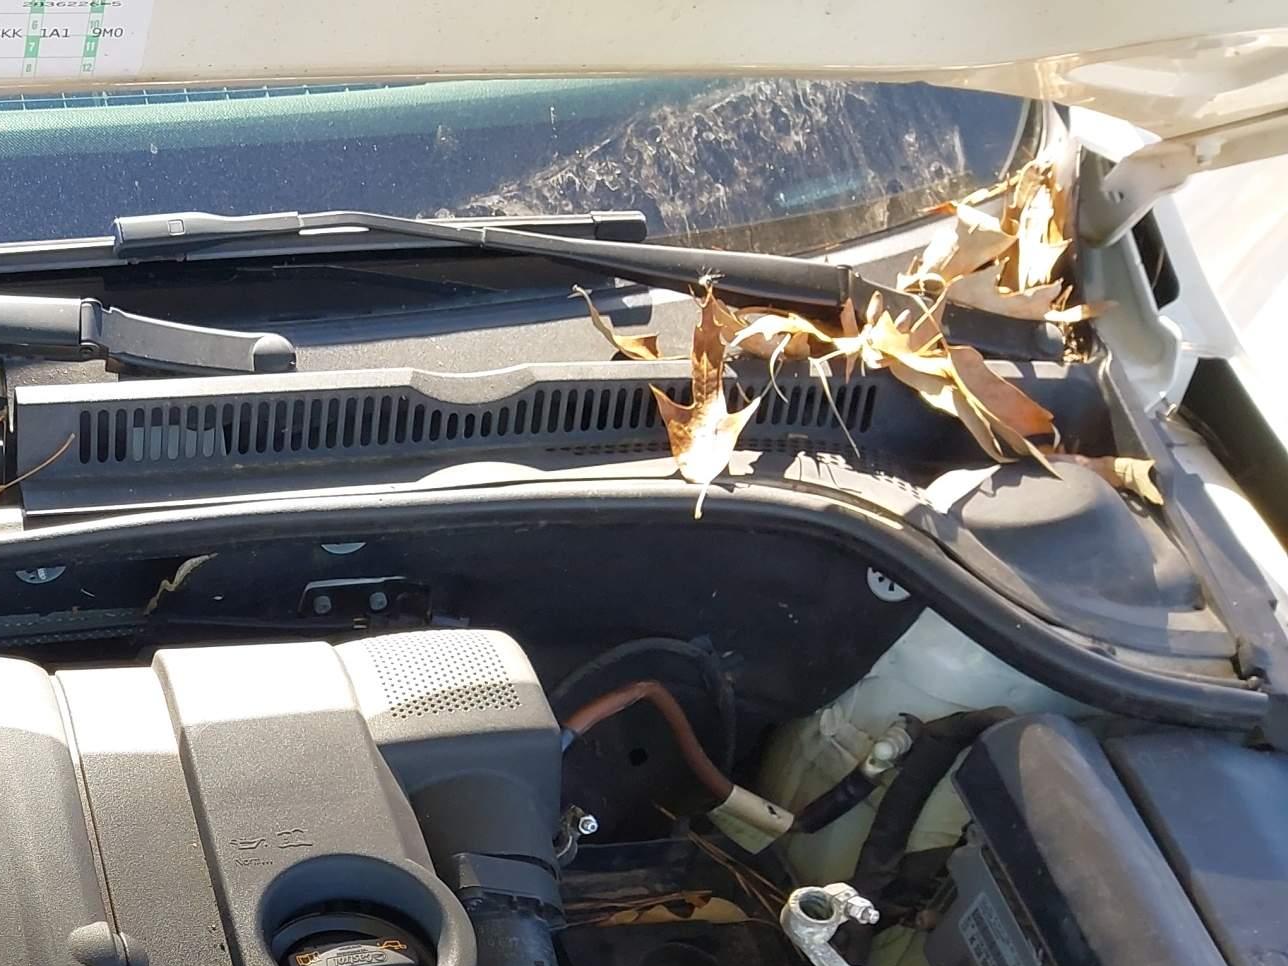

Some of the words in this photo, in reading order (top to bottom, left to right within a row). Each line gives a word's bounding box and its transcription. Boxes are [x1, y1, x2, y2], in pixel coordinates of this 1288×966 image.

[31, 20, 39, 31] 6
[40, 28, 71, 39] 1A1
[28, 41, 36, 52] 7
[86, 41, 96, 52] 11
[81, 63, 93, 73] 12
